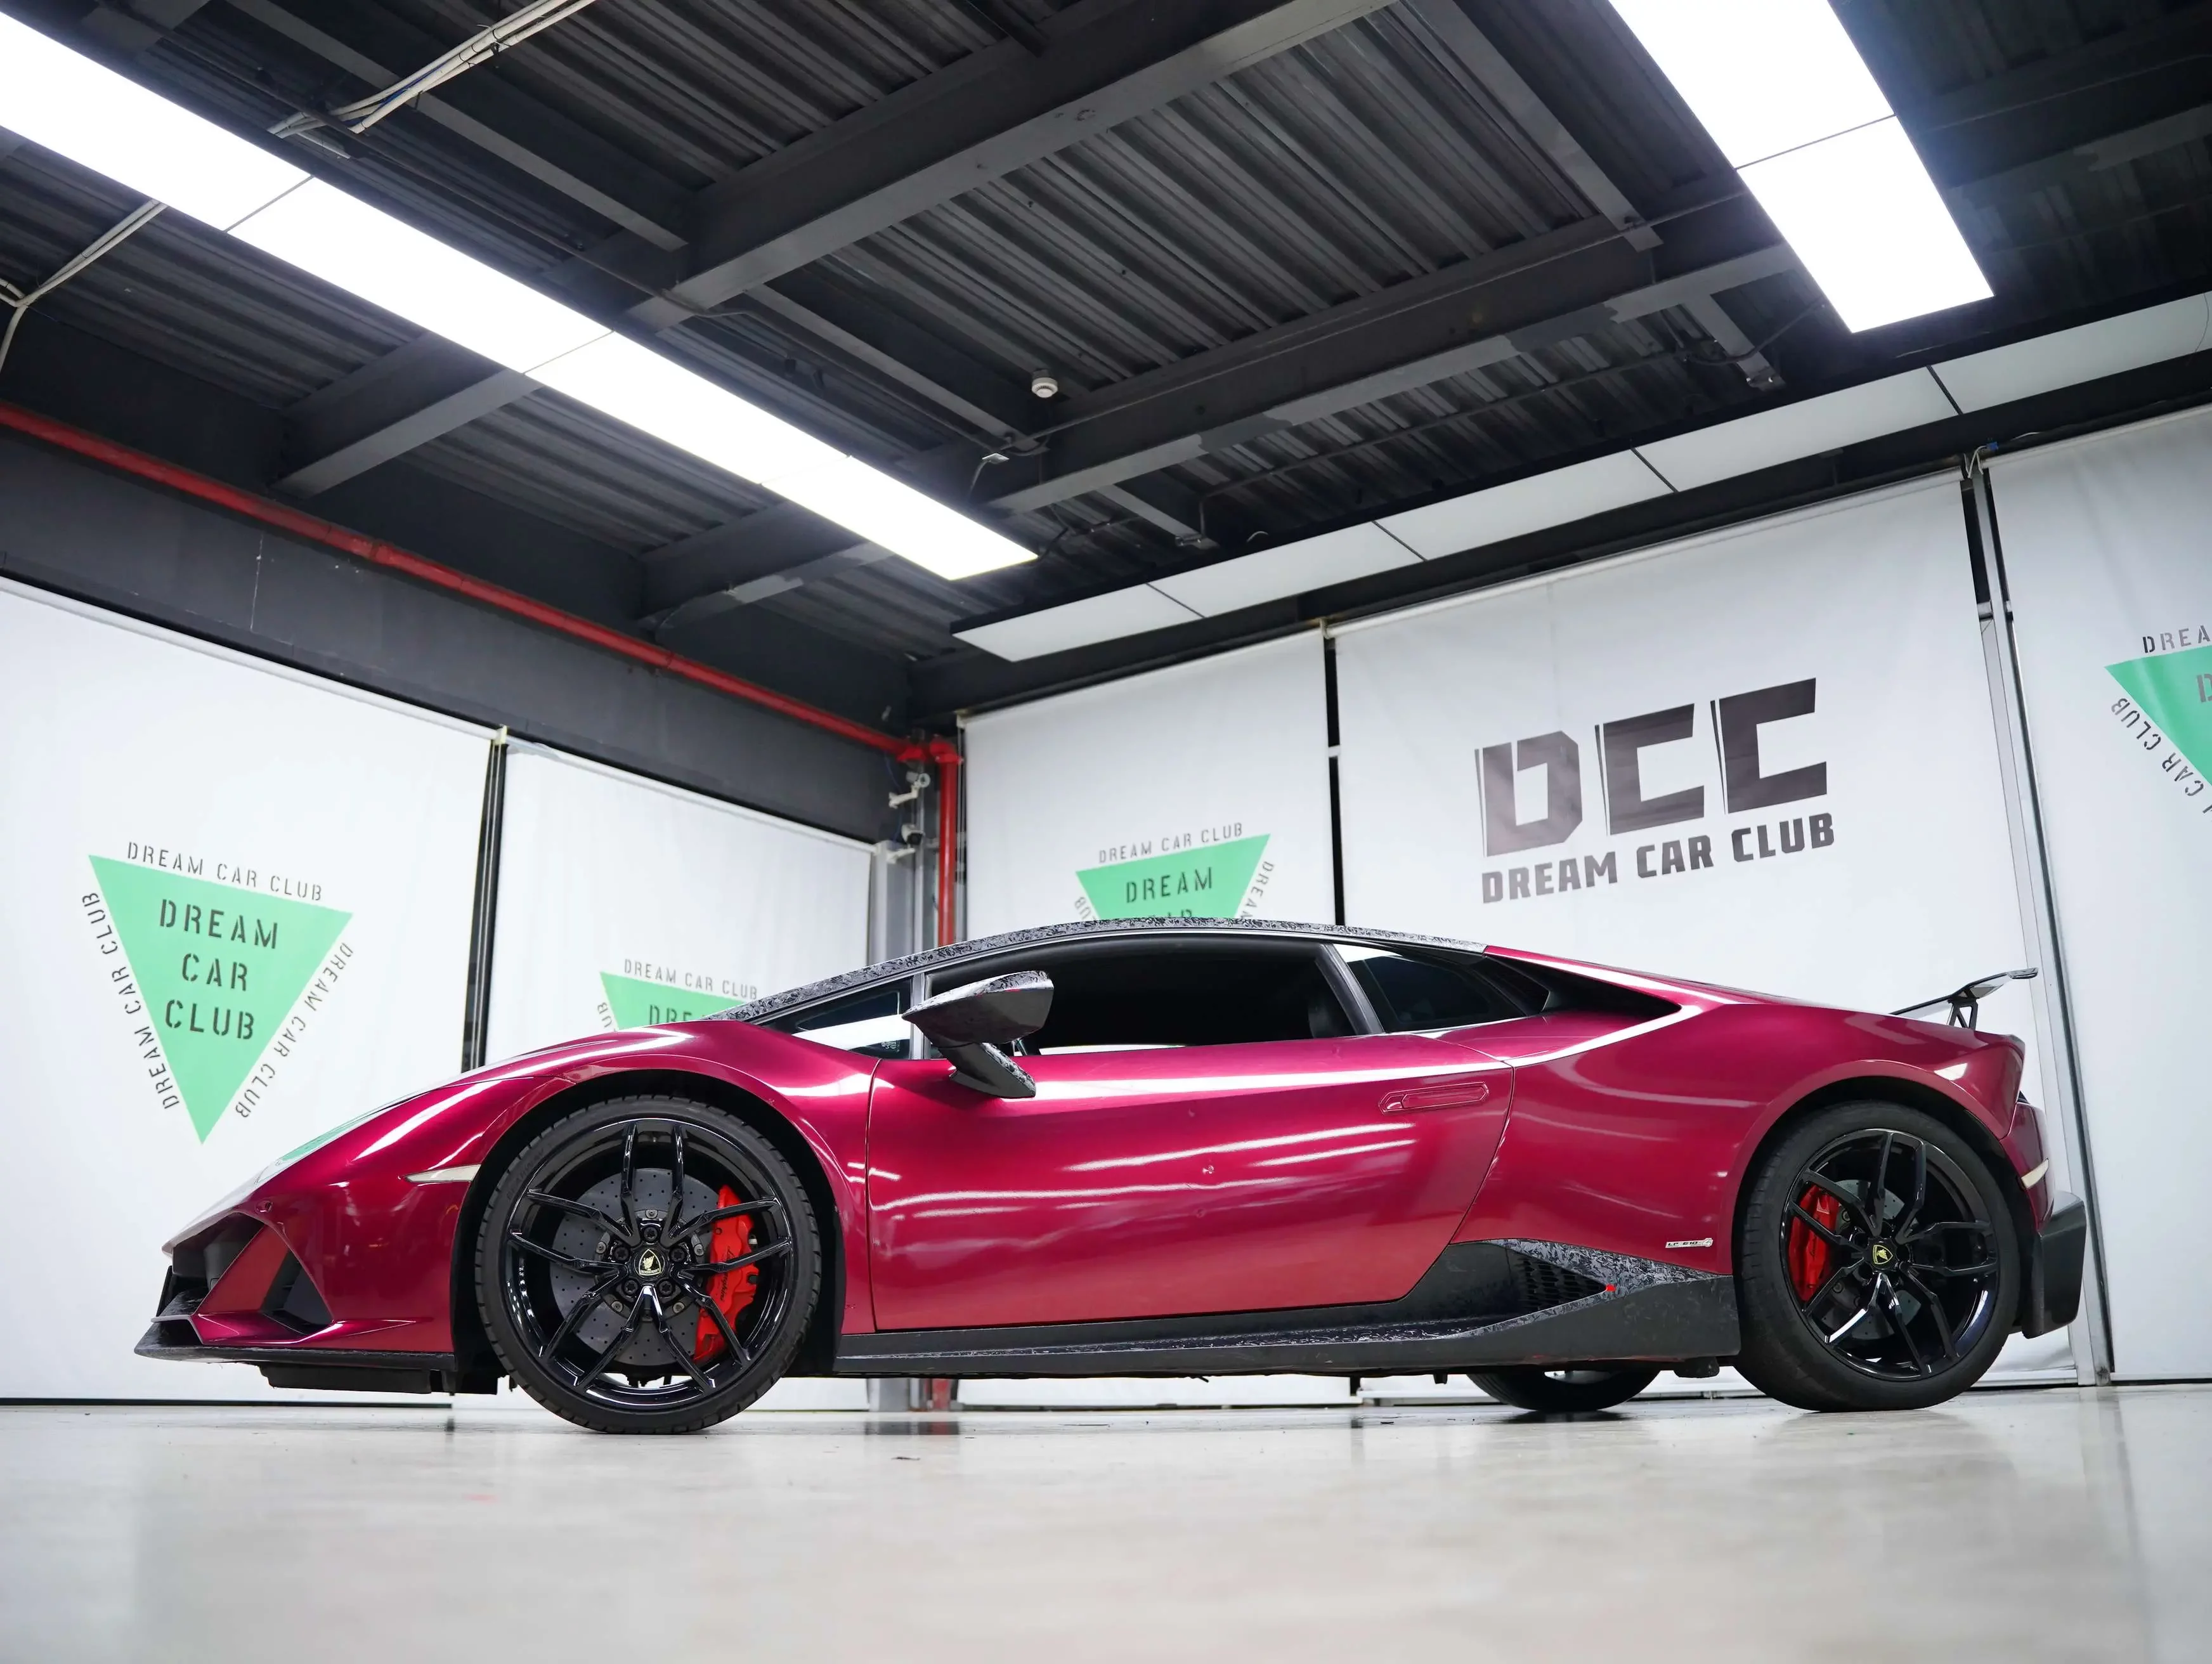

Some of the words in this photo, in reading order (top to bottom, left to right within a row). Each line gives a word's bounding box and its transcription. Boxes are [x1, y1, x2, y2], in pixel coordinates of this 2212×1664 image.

[2142, 625, 2211, 653] DREA
[2111, 698, 2161, 750] CLUB
[1474, 677, 1827, 857] DCC
[2162, 752, 2204, 796] CAR
[1099, 841, 1152, 863] DREAM
[1161, 833, 1192, 852] CAR
[1202, 822, 1242, 843] CLUB
[1482, 852, 1617, 904] DREAM
[1637, 835, 1714, 878] CAR
[1731, 813, 1835, 862] CLUB
[127, 841, 203, 876] DREAM
[216, 863, 257, 888] CAR
[270, 875, 322, 901] CLUB
[1126, 867, 1213, 904] DREAM
[82, 892, 119, 955] CLUB
[159, 899, 278, 949] DREAM
[111, 966, 141, 1015] CAR
[181, 953, 247, 992] CAR
[304, 942, 353, 1011] DREAM
[624, 958, 676, 984] DREAM
[685, 972, 713, 991] CAR
[722, 980, 758, 1000] CLUB
[165, 999, 254, 1040] CLUB
[273, 1016, 306, 1058] CAR
[134, 1025, 179, 1109] DREAM
[235, 1063, 275, 1118] CLUB
